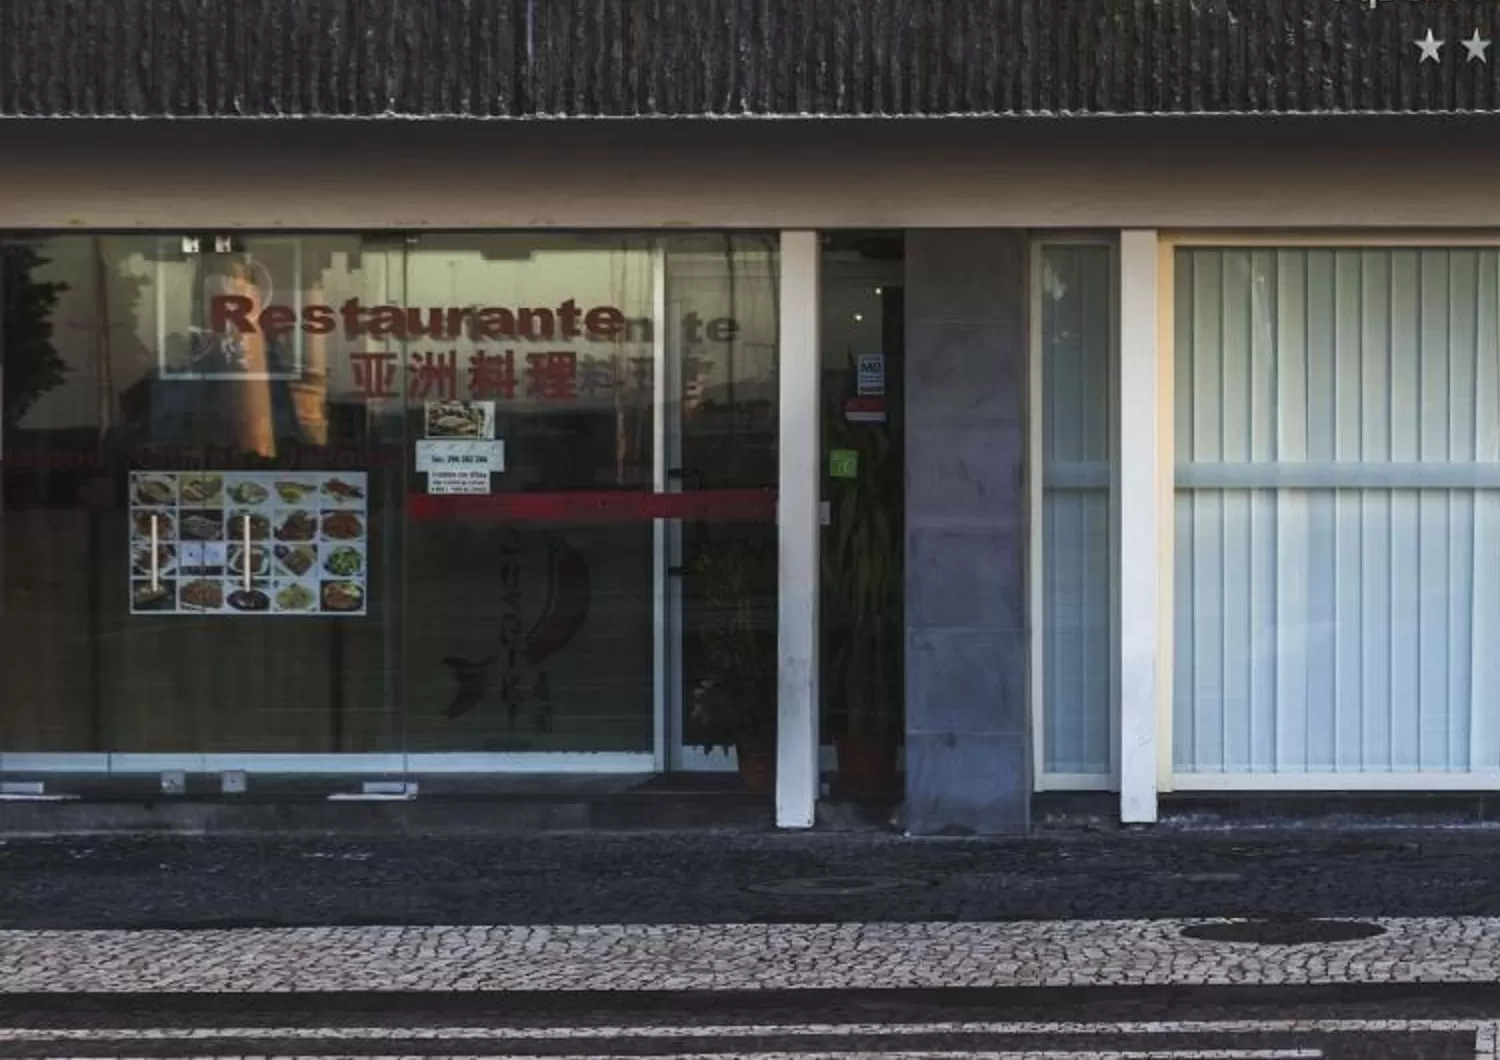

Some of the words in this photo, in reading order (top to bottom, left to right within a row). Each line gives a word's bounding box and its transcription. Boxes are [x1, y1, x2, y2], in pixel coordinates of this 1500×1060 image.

[210, 295, 625, 338] Restaurante
[350, 350, 577, 399] 亚洲料理
